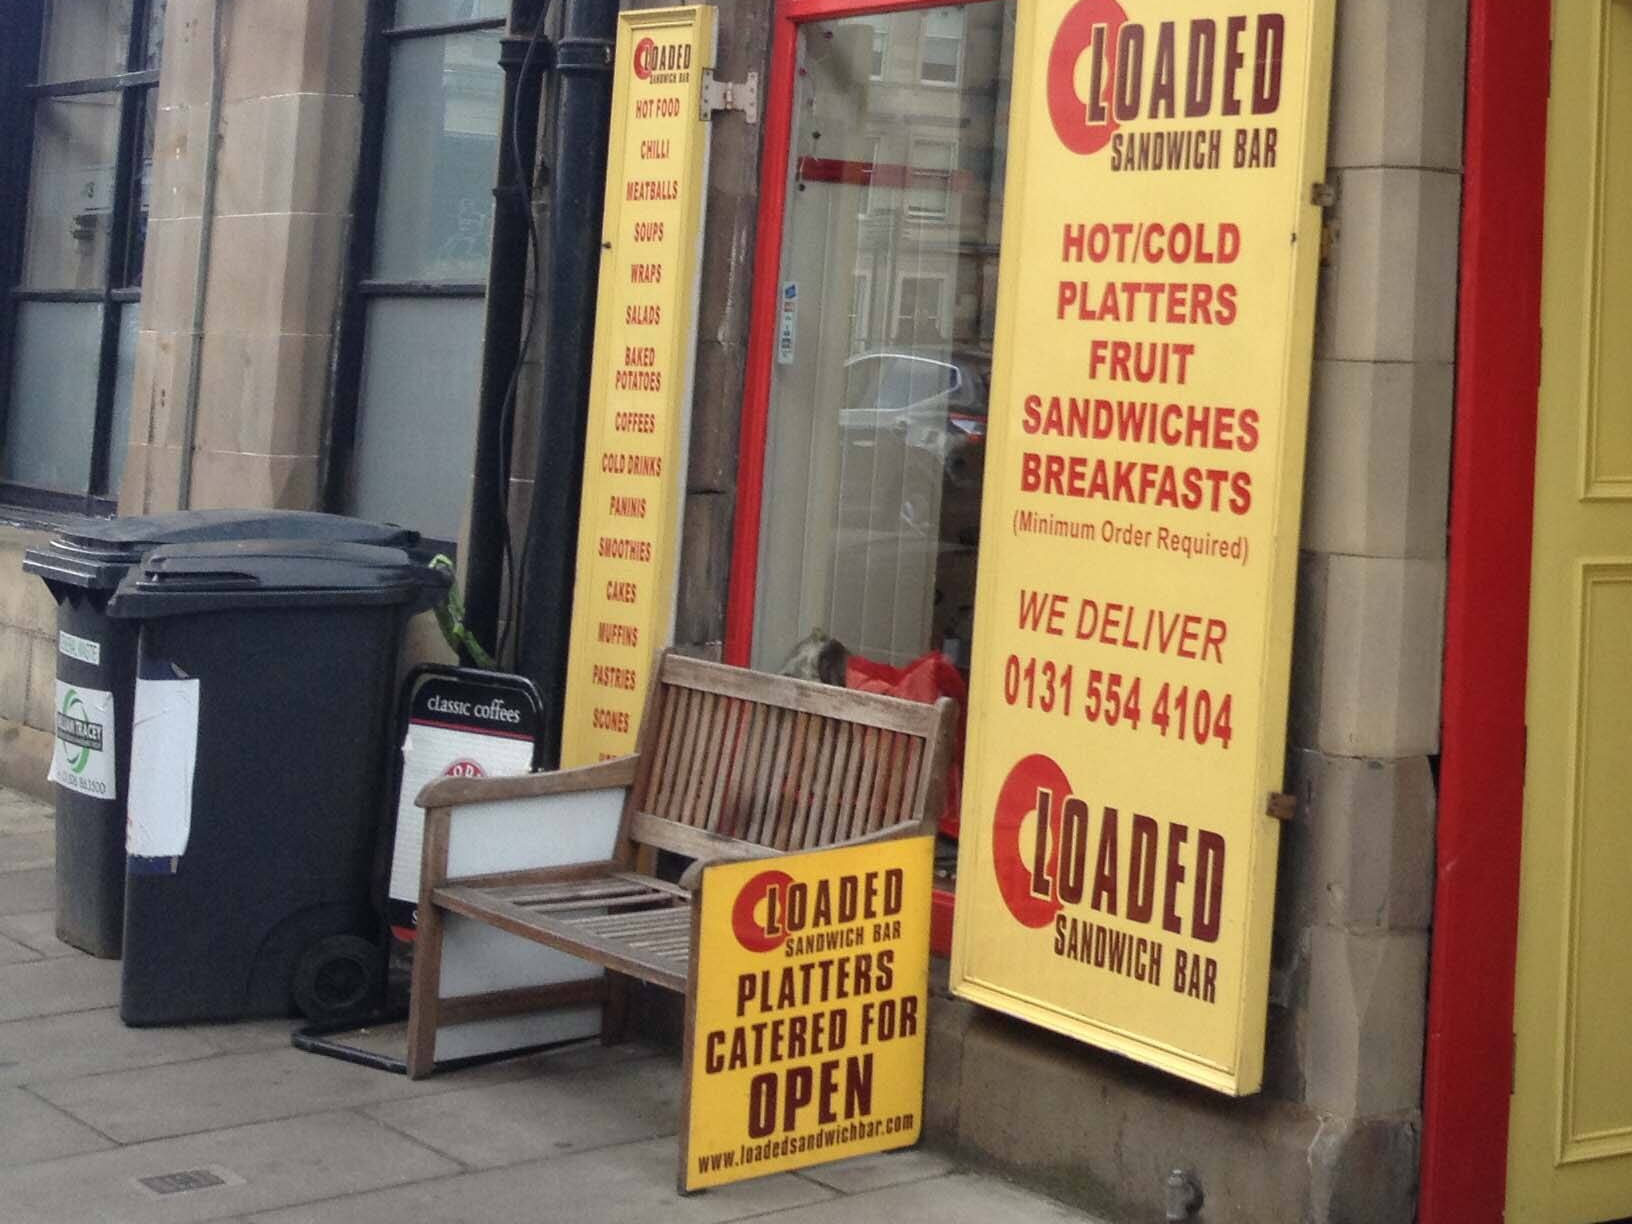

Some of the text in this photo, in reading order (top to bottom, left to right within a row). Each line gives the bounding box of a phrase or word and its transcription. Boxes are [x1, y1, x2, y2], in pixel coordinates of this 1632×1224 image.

[644, 44, 692, 71] LOADED
[1087, 12, 1286, 123] LOADED
[636, 98, 680, 119] HOT FOOD
[640, 139, 669, 160] CHILLI
[1111, 128, 1278, 172] SANDWICH BAR
[626, 180, 678, 201] MEATBALLS
[634, 222, 664, 242] SOUPS
[630, 263, 662, 284] WRAPS
[625, 304, 661, 325] SALADS
[1057, 281, 1238, 326] PLATTERS
[624, 346, 656, 367] BAKED
[1088, 340, 1195, 385] FRUIT
[615, 370, 662, 392] POTATOES
[615, 411, 656, 433] COFFEES
[1021, 394, 1261, 453] SANDWICHES
[602, 453, 662, 477] COLD DRINKS
[1020, 451, 1253, 516] BREAKFASTS
[609, 495, 647, 519] PANINIS
[599, 536, 652, 562] SMOOTHIES
[1013, 510, 1249, 565] (Minimum Order Required)
[606, 580, 637, 604] CAKES
[598, 622, 639, 648] MUFFINS
[1018, 589, 1228, 665] WE DELIVER
[592, 664, 636, 691] PASTRIES
[427, 695, 521, 723] classic coffees
[1004, 655, 1233, 749] 0131 554 4104
[1032, 789, 1226, 943] LOADED
[766, 868, 904, 936] LOADED
[785, 920, 902, 958] SANDWICH BAR
[1053, 913, 1217, 1004] SANDWICH BAR
[736, 949, 894, 1017] PLATTERS
[705, 995, 918, 1075] CATERED FOR
[748, 1053, 874, 1140] OPEN
[698, 1112, 914, 1174] www.loadedsandwichbar.com
